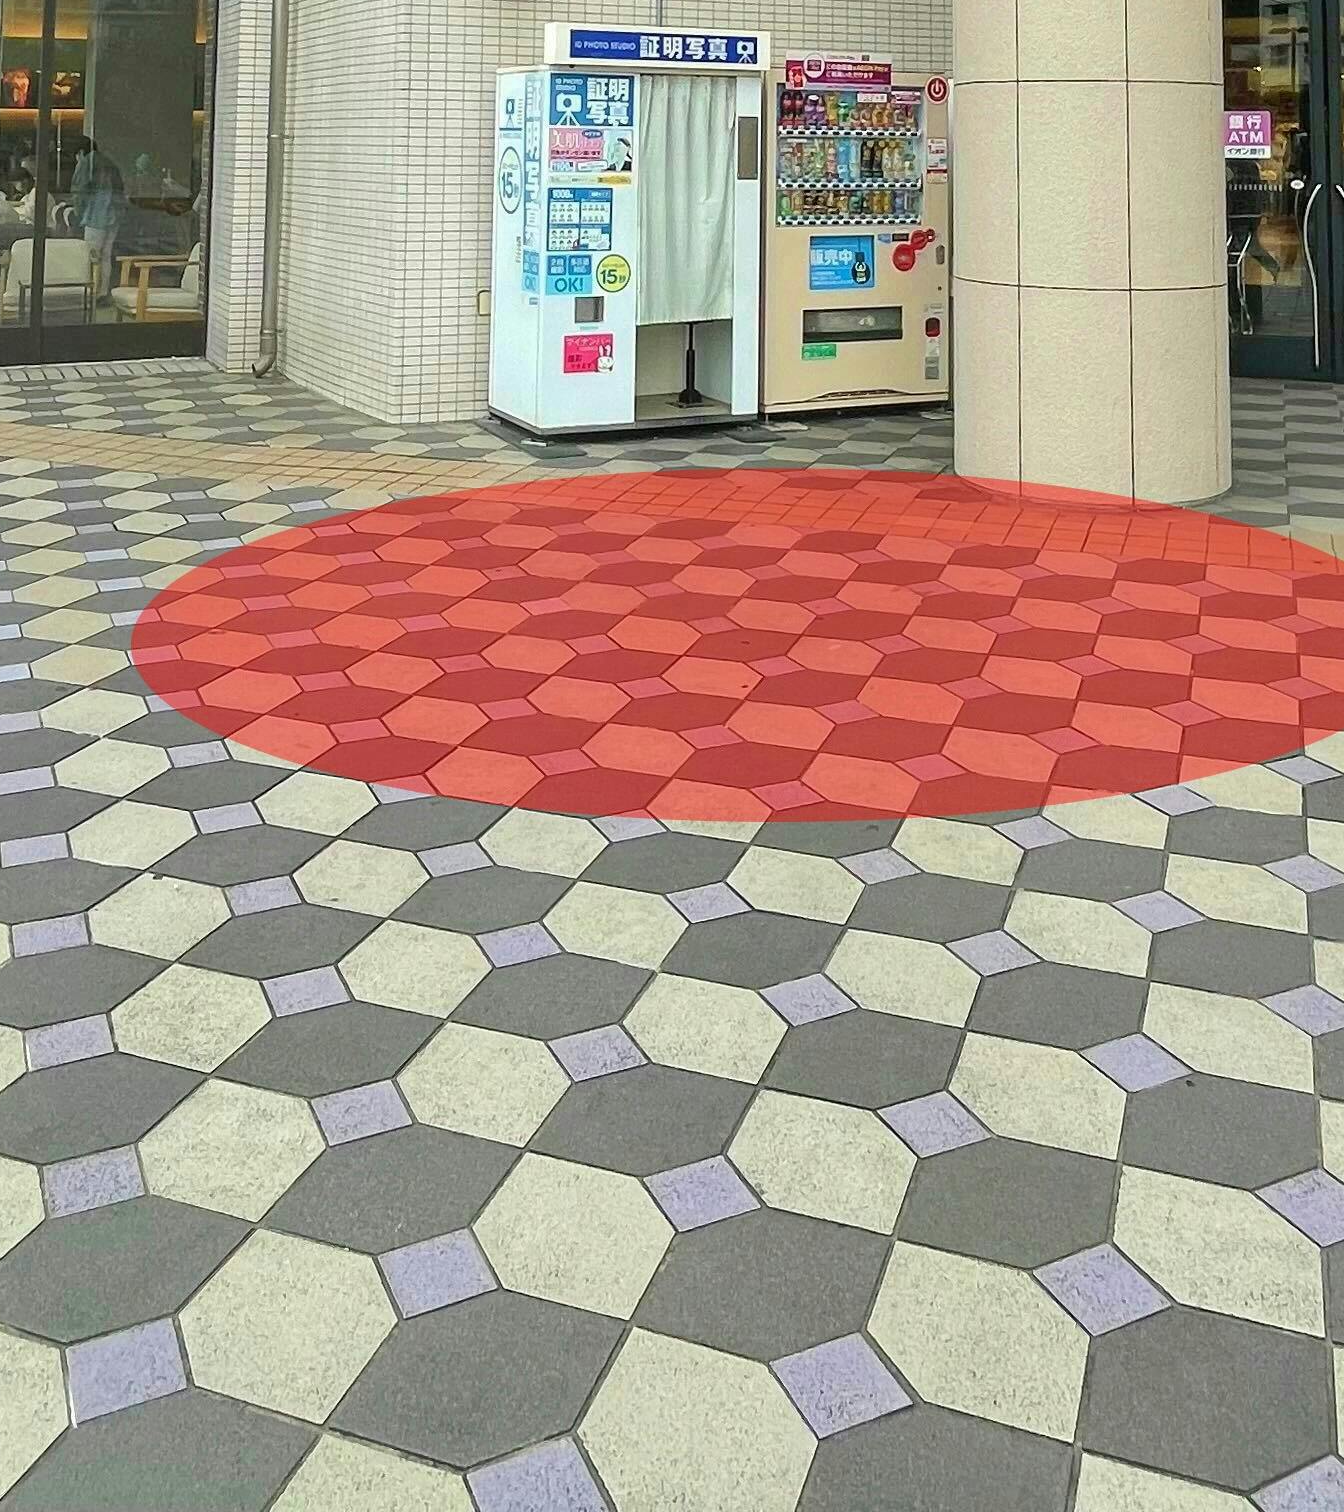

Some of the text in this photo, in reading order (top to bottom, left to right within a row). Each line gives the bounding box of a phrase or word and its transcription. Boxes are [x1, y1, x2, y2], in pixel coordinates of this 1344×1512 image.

[639, 35, 728, 61] 証明写真
[586, 77, 630, 102] 証明
[586, 101, 629, 126] 写真
[1228, 131, 1264, 144] ATM
[554, 277, 584, 293] OK!
